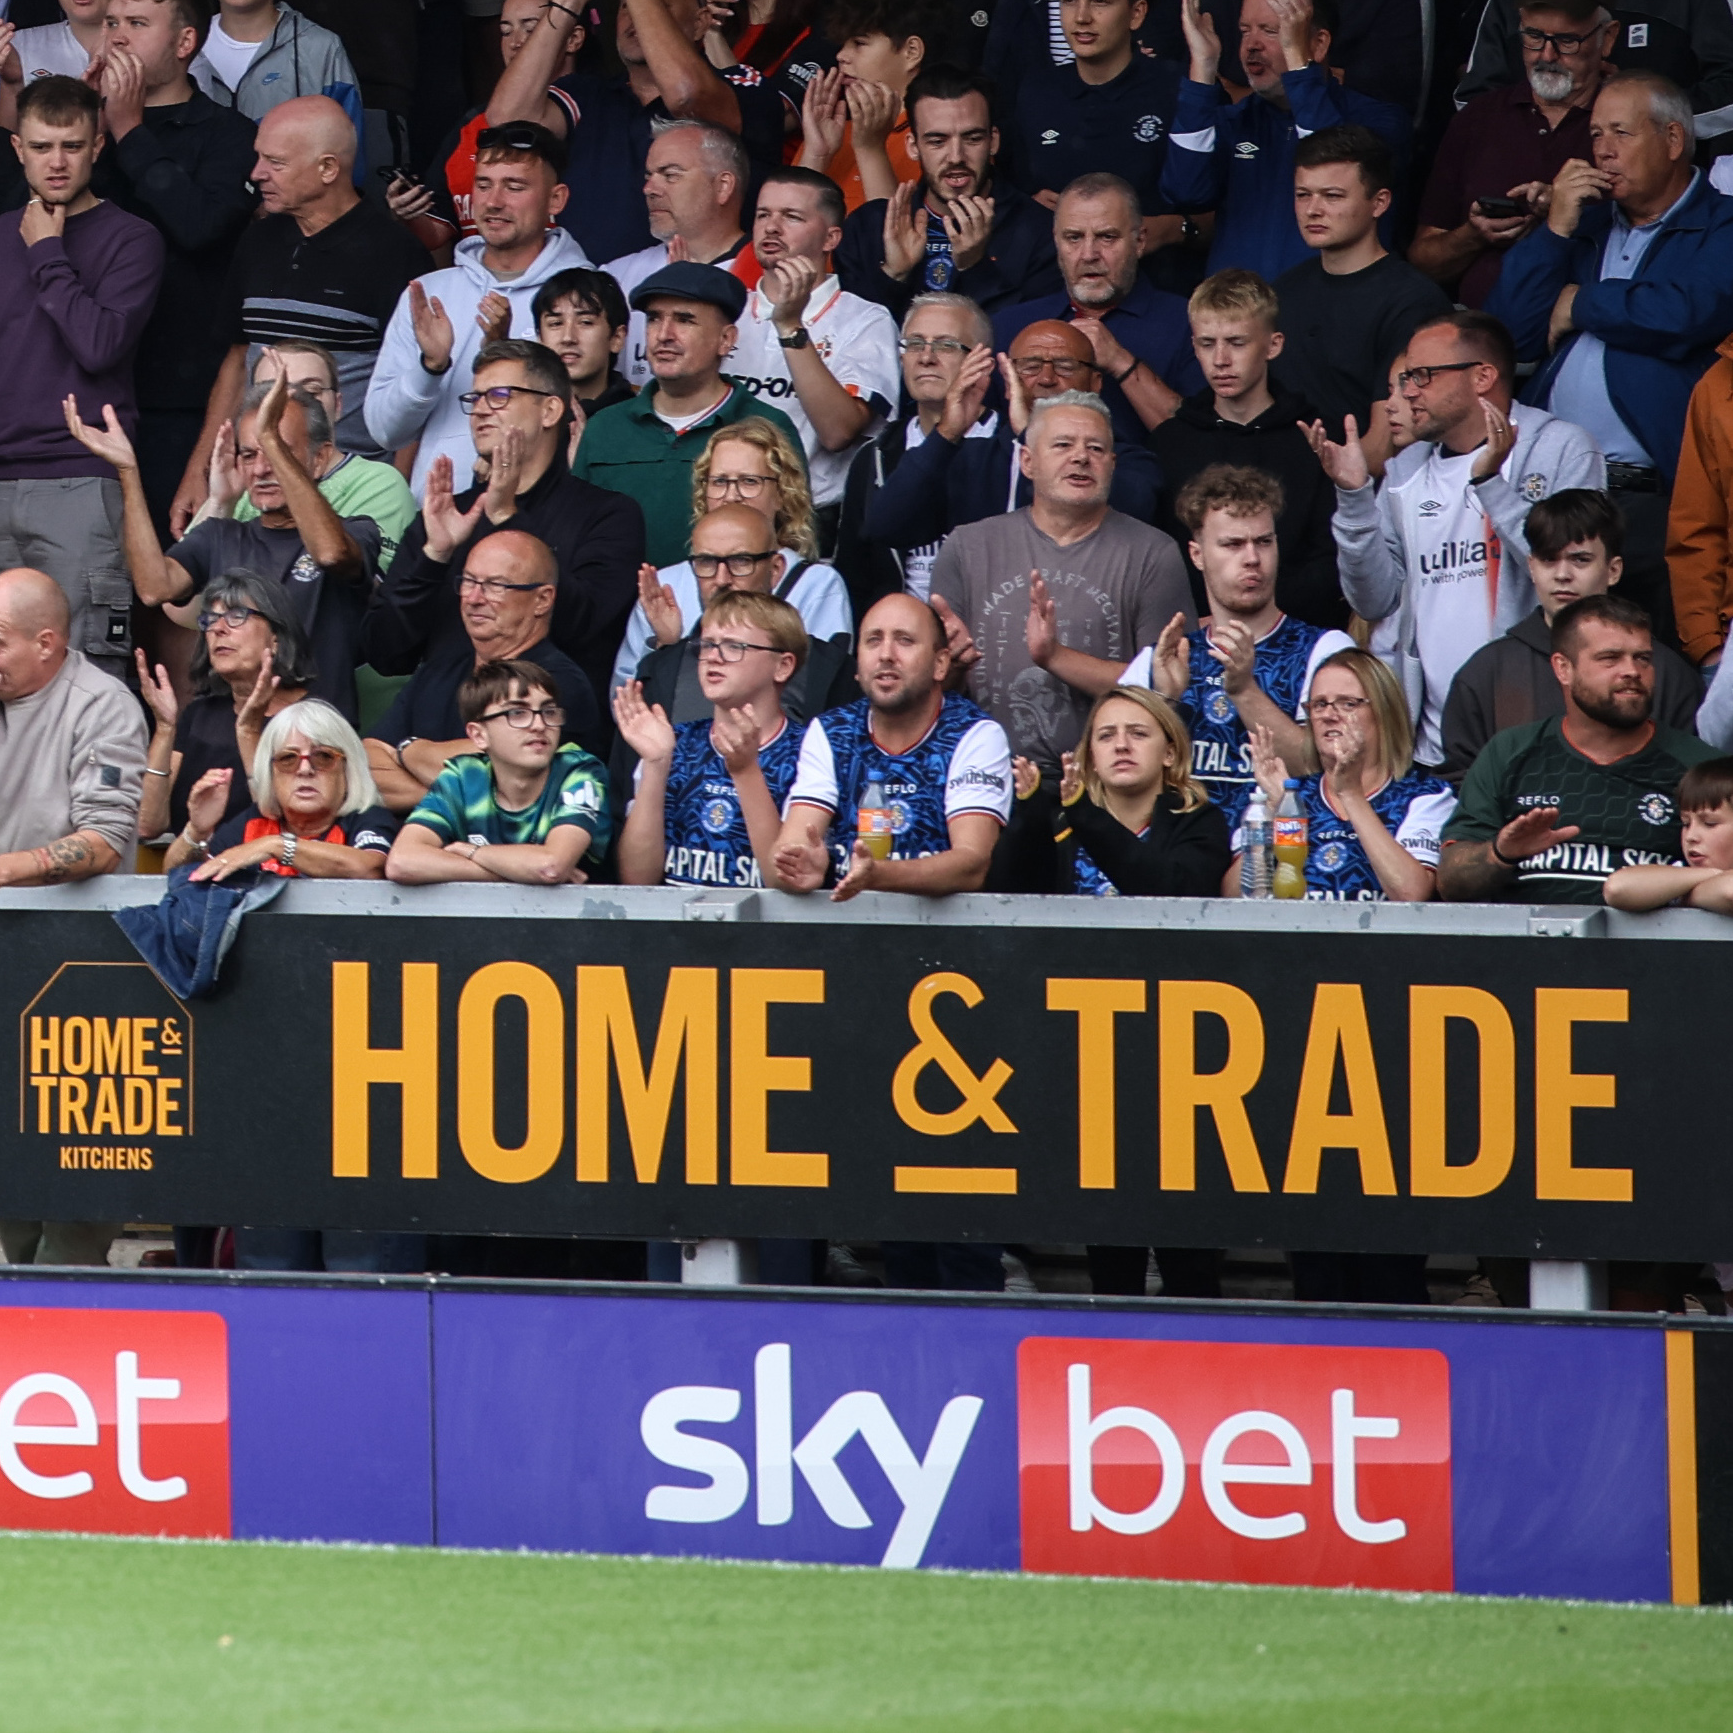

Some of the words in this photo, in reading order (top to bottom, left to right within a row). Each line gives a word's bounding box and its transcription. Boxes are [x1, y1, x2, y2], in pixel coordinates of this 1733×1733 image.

[982, 574, 1026, 615] MADE
[1517, 794, 1560, 807] REFLO
[30, 1015, 159, 1075] HOME
[30, 1076, 184, 1136] TRADE
[332, 961, 830, 1188] HOME
[891, 972, 1019, 1195] &
[1046, 978, 1634, 1202] TRADE
[59, 1146, 154, 1171] KITCHENS
[640, 1342, 983, 1567] sky
[1066, 1362, 1407, 1545] bet
